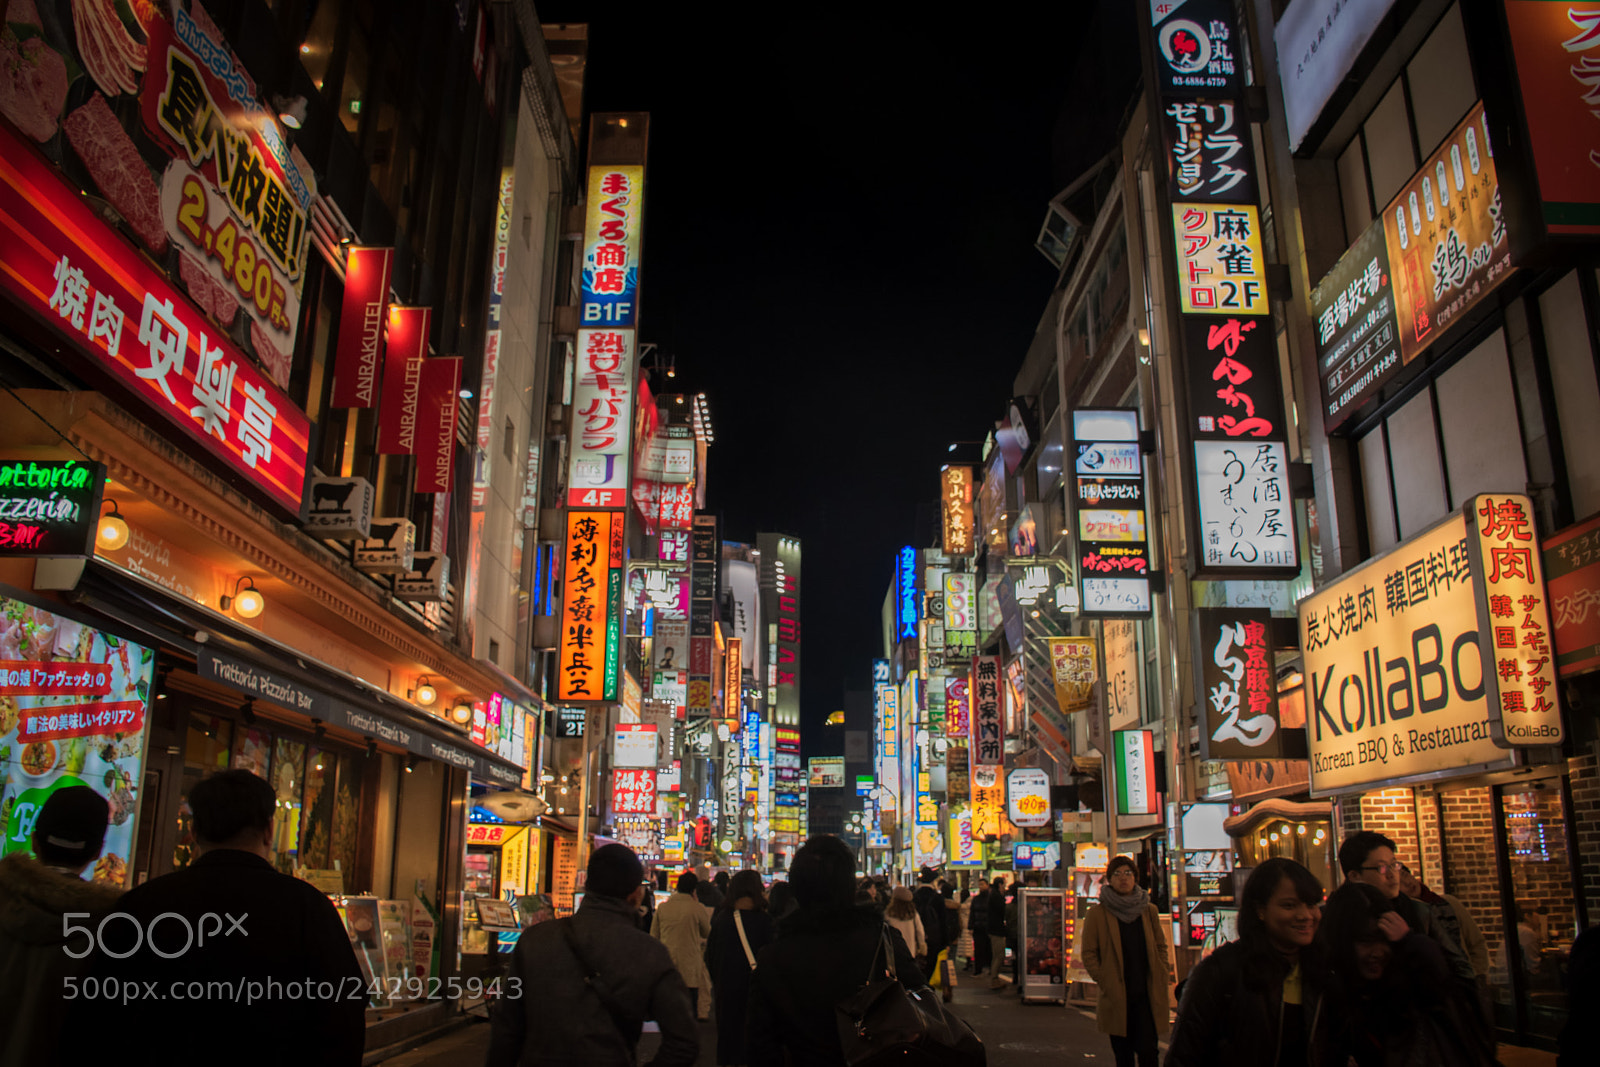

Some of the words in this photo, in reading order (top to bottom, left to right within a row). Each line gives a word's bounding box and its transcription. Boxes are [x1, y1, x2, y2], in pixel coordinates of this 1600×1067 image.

[1156, 4, 1172, 14] 4F
[161, 52, 302, 275] 食べ放題!
[594, 172, 630, 294] まぐろ商店
[1182, 208, 1217, 309] クアトロ
[1213, 209, 1256, 275] 麻雀
[50, 255, 125, 357] 焼肉
[584, 303, 631, 322] B1F
[1220, 281, 1260, 309] 2F
[1319, 257, 1382, 346] 酒場牧場
[356, 302, 381, 402] ANRAKUTEI
[578, 332, 629, 450] 熟女キャバクラ
[399, 357, 421, 450] ANRAKUTEI
[435, 402, 453, 488] ANRAKUTEI
[1329, 398, 1340, 416] TEL
[582, 490, 612, 507] 4F
[1079, 484, 1141, 500] 日本人セラピスト
[1086, 521, 1130, 533] クアトロ
[1220, 450, 1259, 563] うまいもん
[1251, 444, 1287, 538] 居酒屋
[1206, 520, 1223, 564] 一番街
[1264, 551, 1293, 564] B1F
[1384, 538, 1472, 618] 韓国料理
[1480, 499, 1536, 585] 焼肉
[1306, 584, 1379, 653] 炭火焼肉
[1490, 594, 1528, 713] 韓国料理
[1518, 595, 1554, 713] サムギョプサル
[212, 657, 258, 690] Trattoria
[260, 673, 295, 706] Pizzeria
[298, 690, 314, 710] Bar
[1244, 619, 1272, 713] 東京豚骨
[1312, 623, 1488, 742] KollaBo
[26, 709, 137, 734] 魔法の美味しいイタリアン
[978, 660, 1000, 760] 無料案内所
[1507, 725, 1560, 738] KollaBo
[615, 770, 654, 791] 湖南
[1314, 749, 1354, 774] Korean
[1357, 737, 1388, 766] BBQ
[1392, 733, 1405, 757] &
